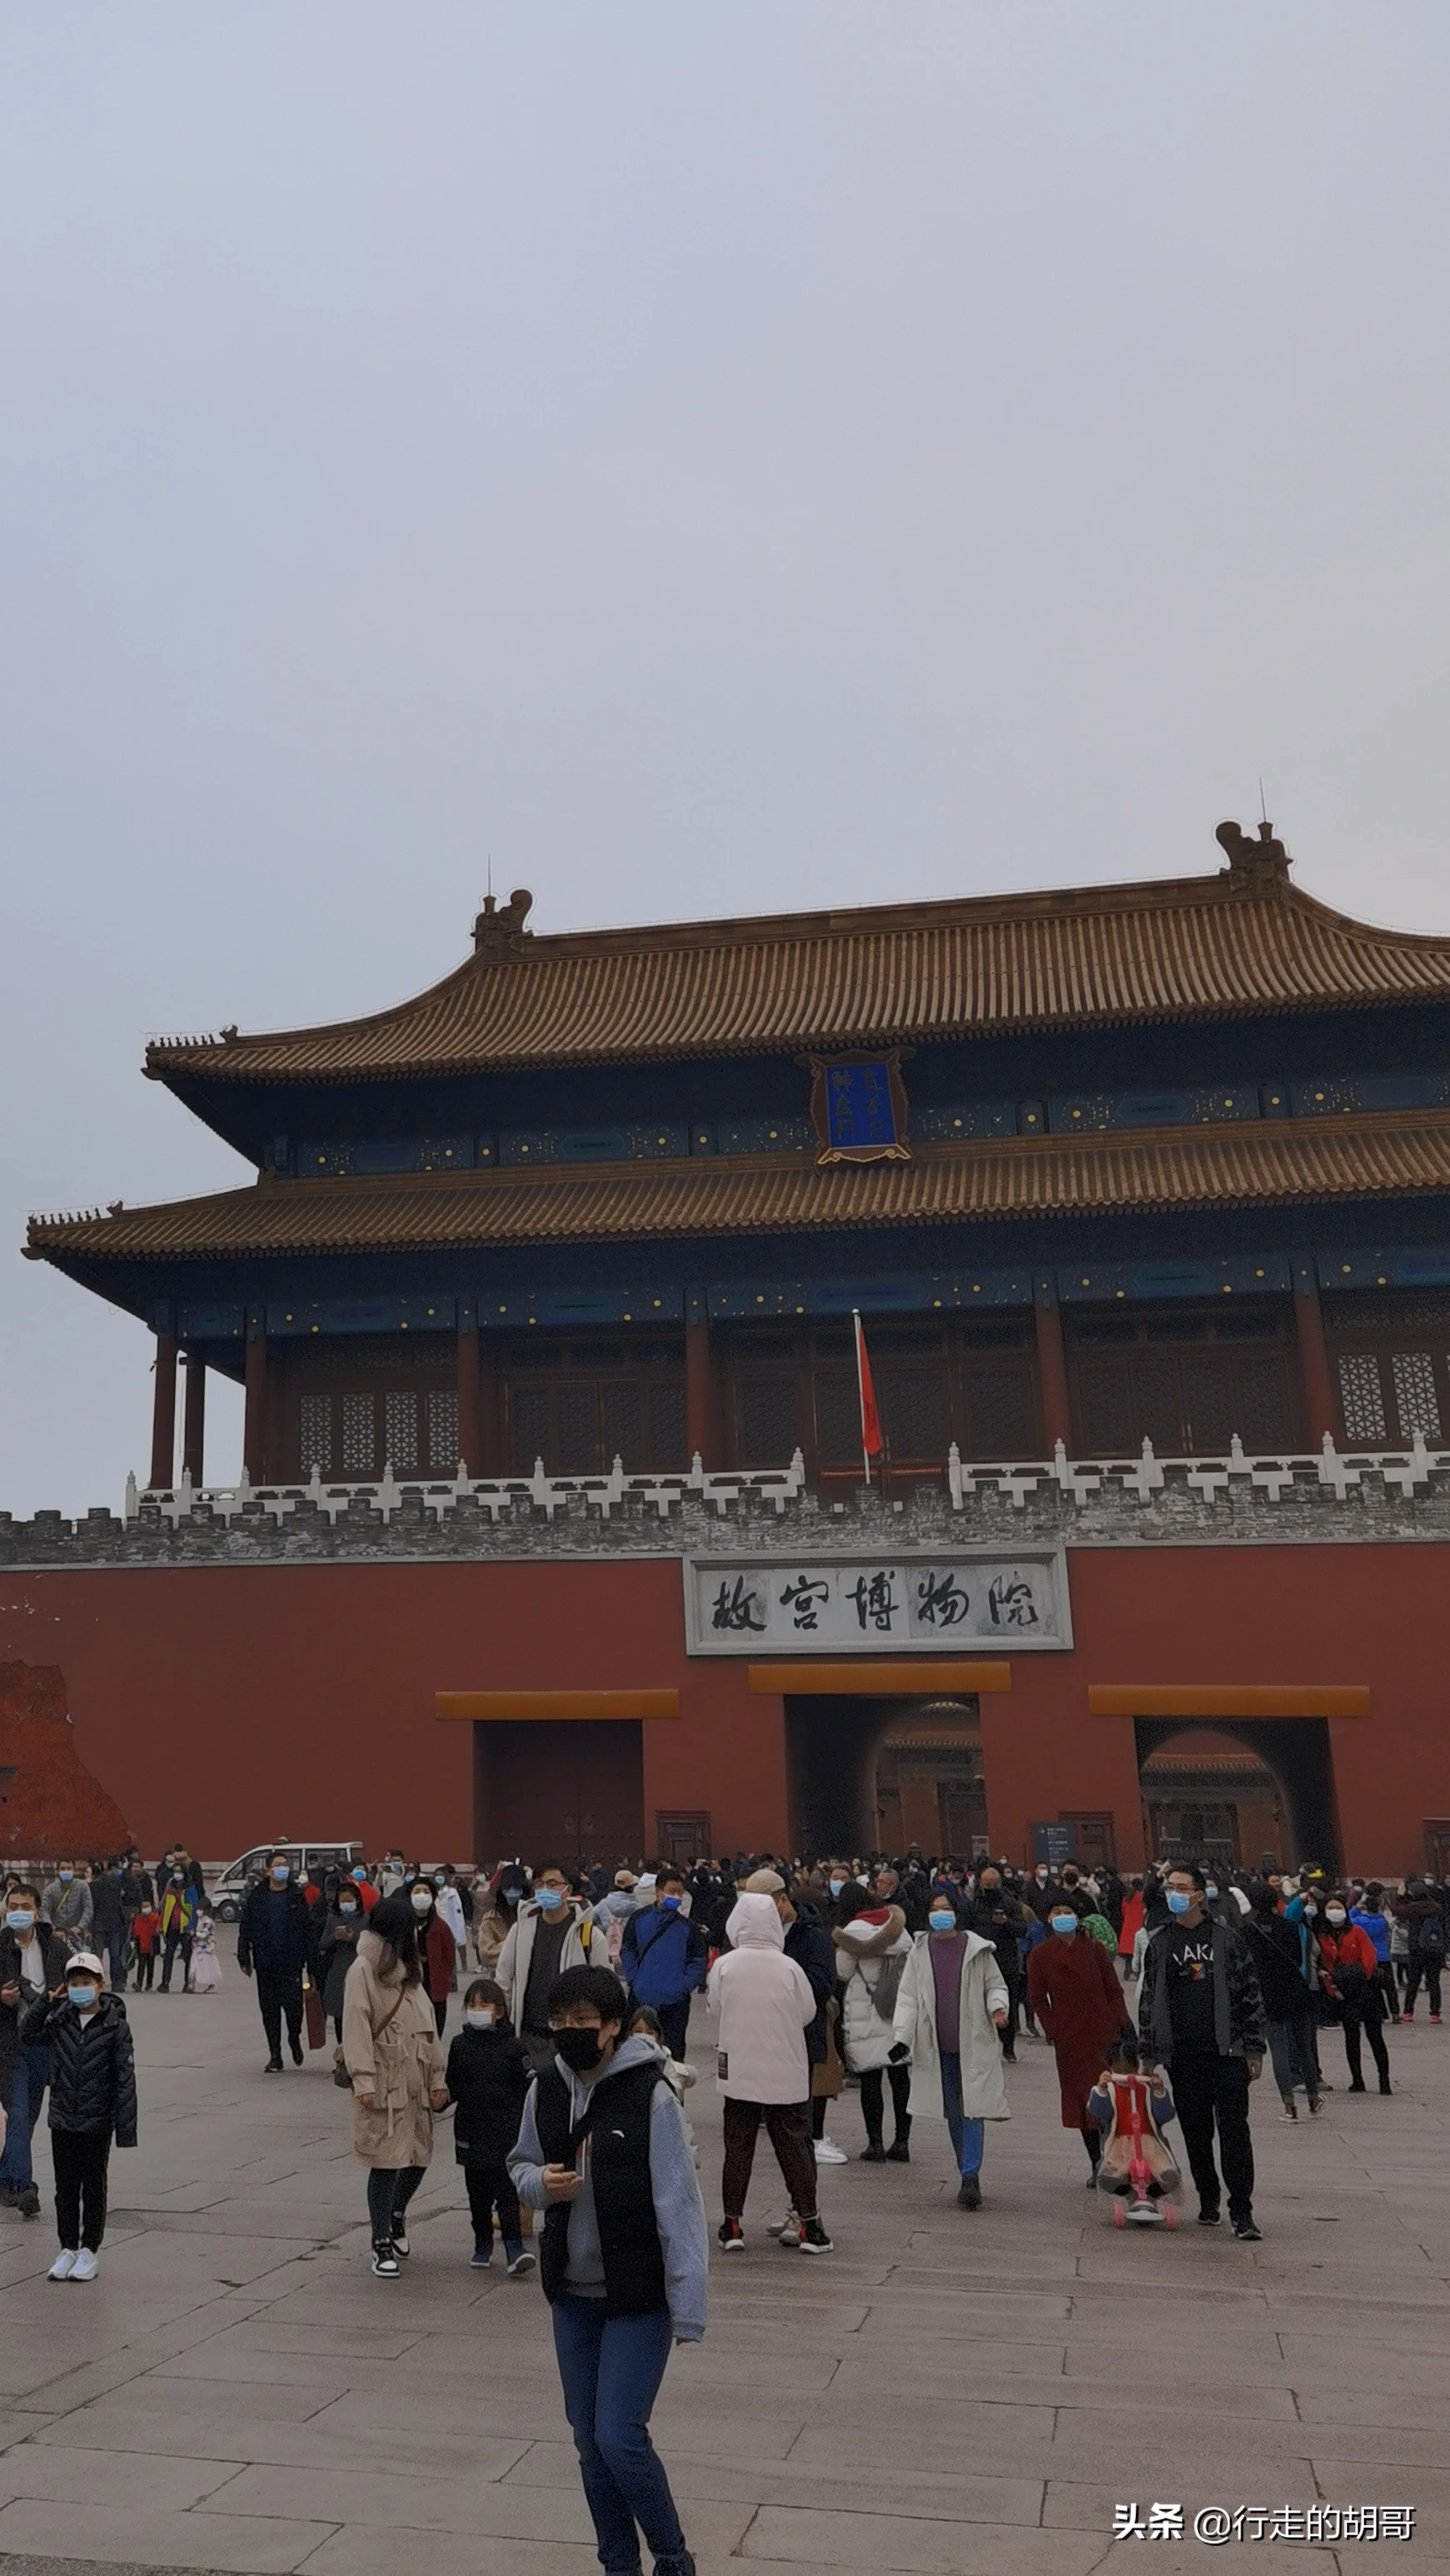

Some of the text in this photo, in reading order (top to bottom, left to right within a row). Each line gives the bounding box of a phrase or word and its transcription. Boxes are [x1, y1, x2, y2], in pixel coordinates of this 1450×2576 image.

[711, 1571, 1039, 1630] 故宫博物院
